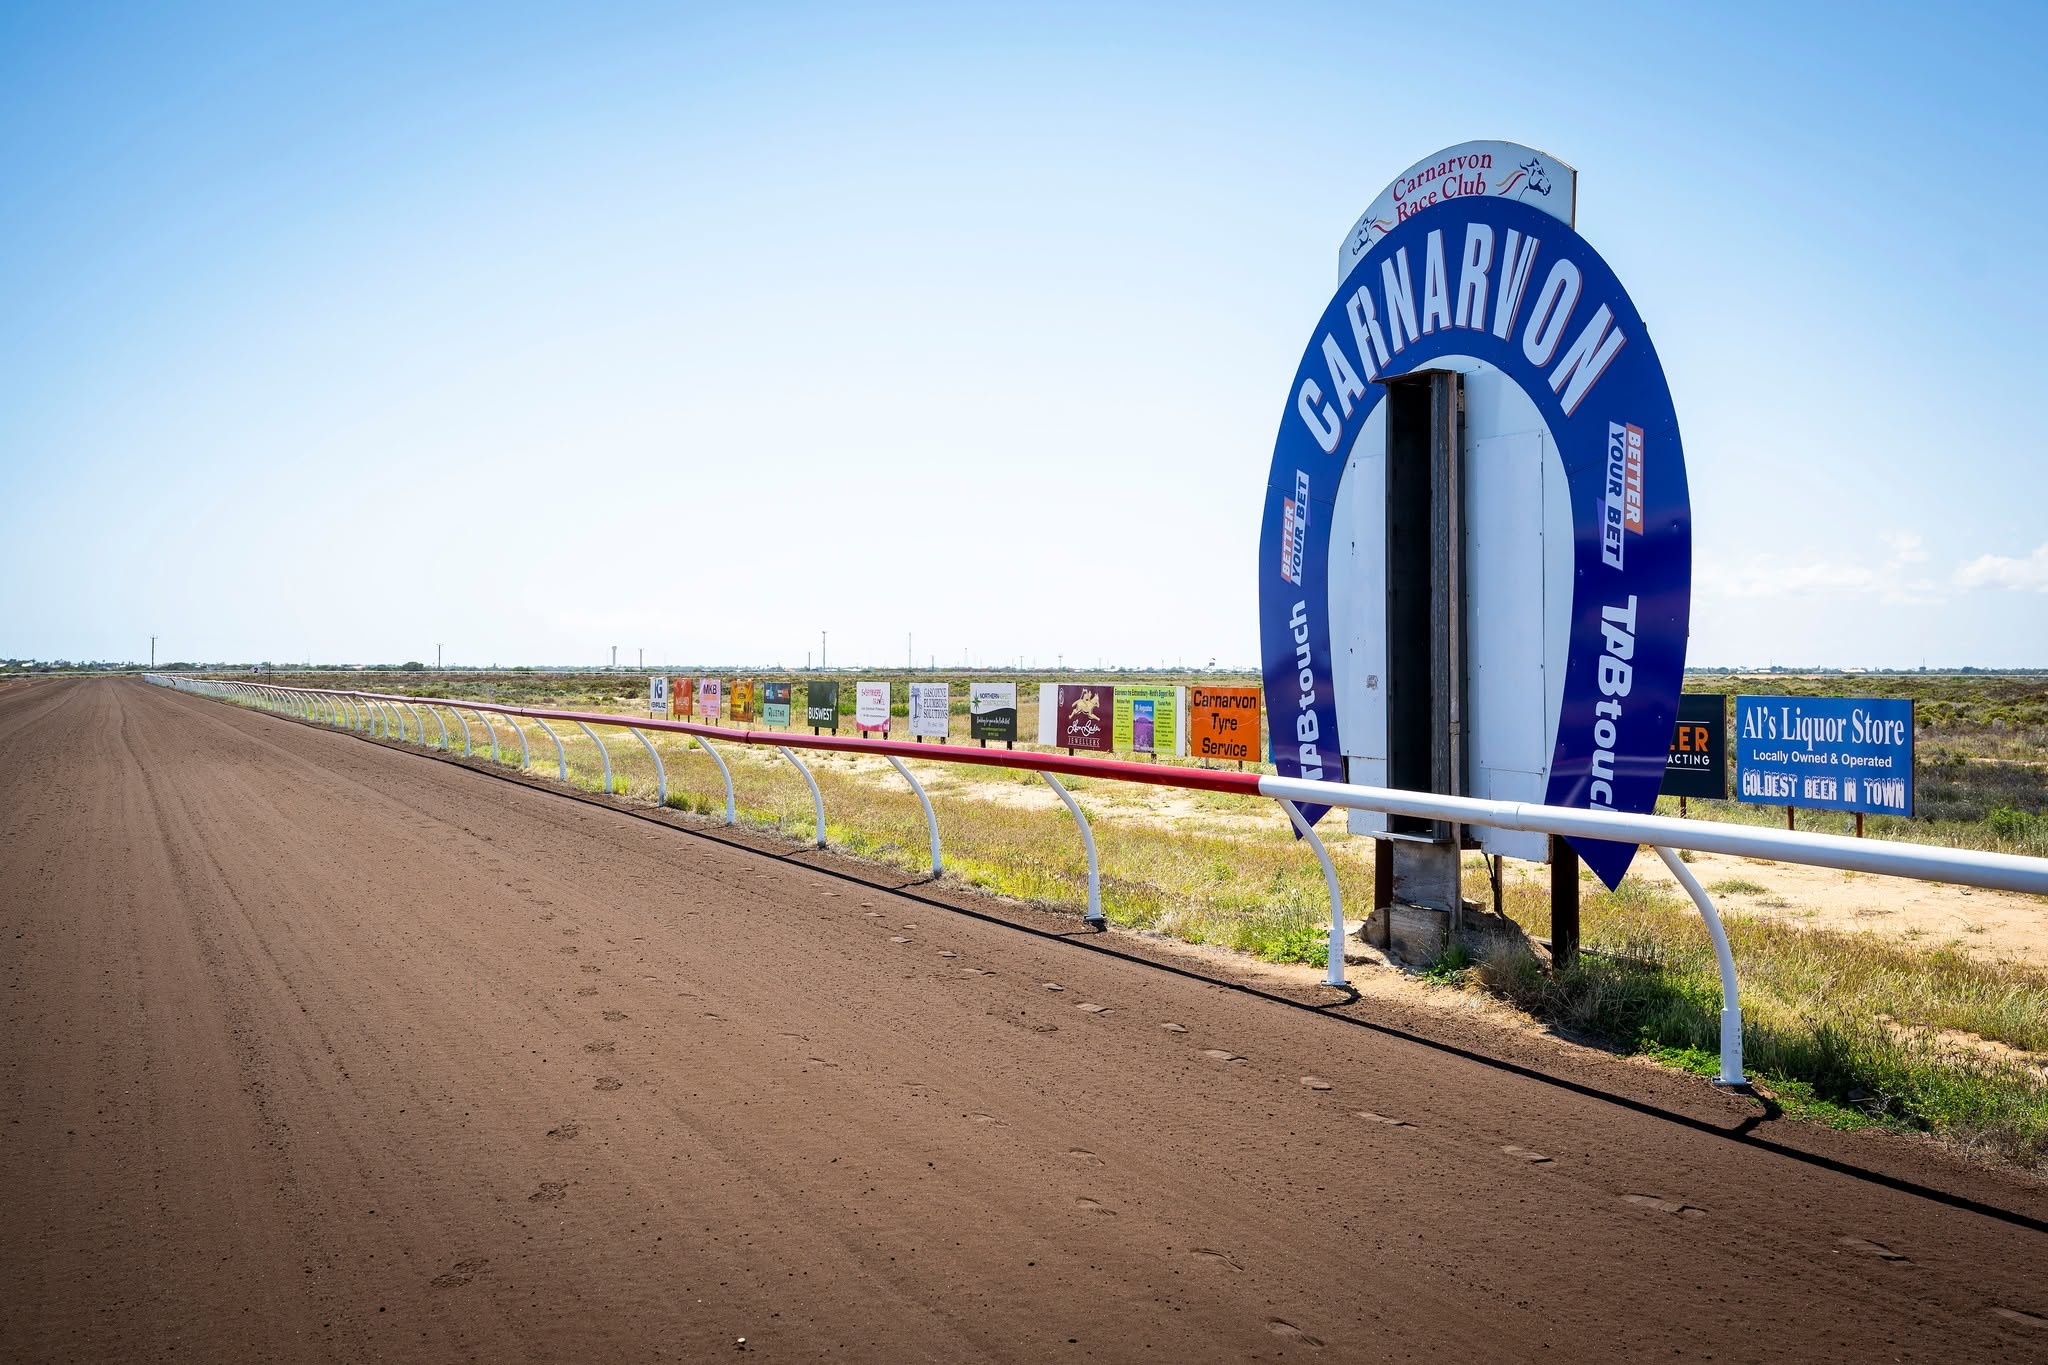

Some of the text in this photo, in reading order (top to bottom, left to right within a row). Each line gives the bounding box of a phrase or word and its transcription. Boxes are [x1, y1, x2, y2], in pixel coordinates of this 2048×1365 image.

[1393, 153, 1492, 201] Carnarvon
[1396, 172, 1486, 224] Race Club
[1298, 222, 1627, 454] CARNARVON
[1606, 432, 1624, 562] YOUR BET
[1626, 431, 1640, 524] BETTER
[1282, 505, 1294, 577] BETTER
[1292, 476, 1307, 577] YOUR BET
[703, 684, 717, 694] MKB
[1194, 690, 1257, 709] Carnarvon
[1590, 595, 1637, 811] TABtouc
[808, 707, 833, 720] BUSWEST
[924, 709, 947, 719] SOLUTIONS
[1211, 712, 1238, 735] Tyre
[1742, 706, 1905, 751] Al's Liquor Store
[1068, 737, 1100, 746] JEWELLERS
[1202, 737, 1247, 757] Service
[1670, 727, 1709, 752] ER
[1753, 749, 1892, 768] Locally Owned & Operated
[1742, 768, 1905, 809] COLDEST BEER IN TOWN
